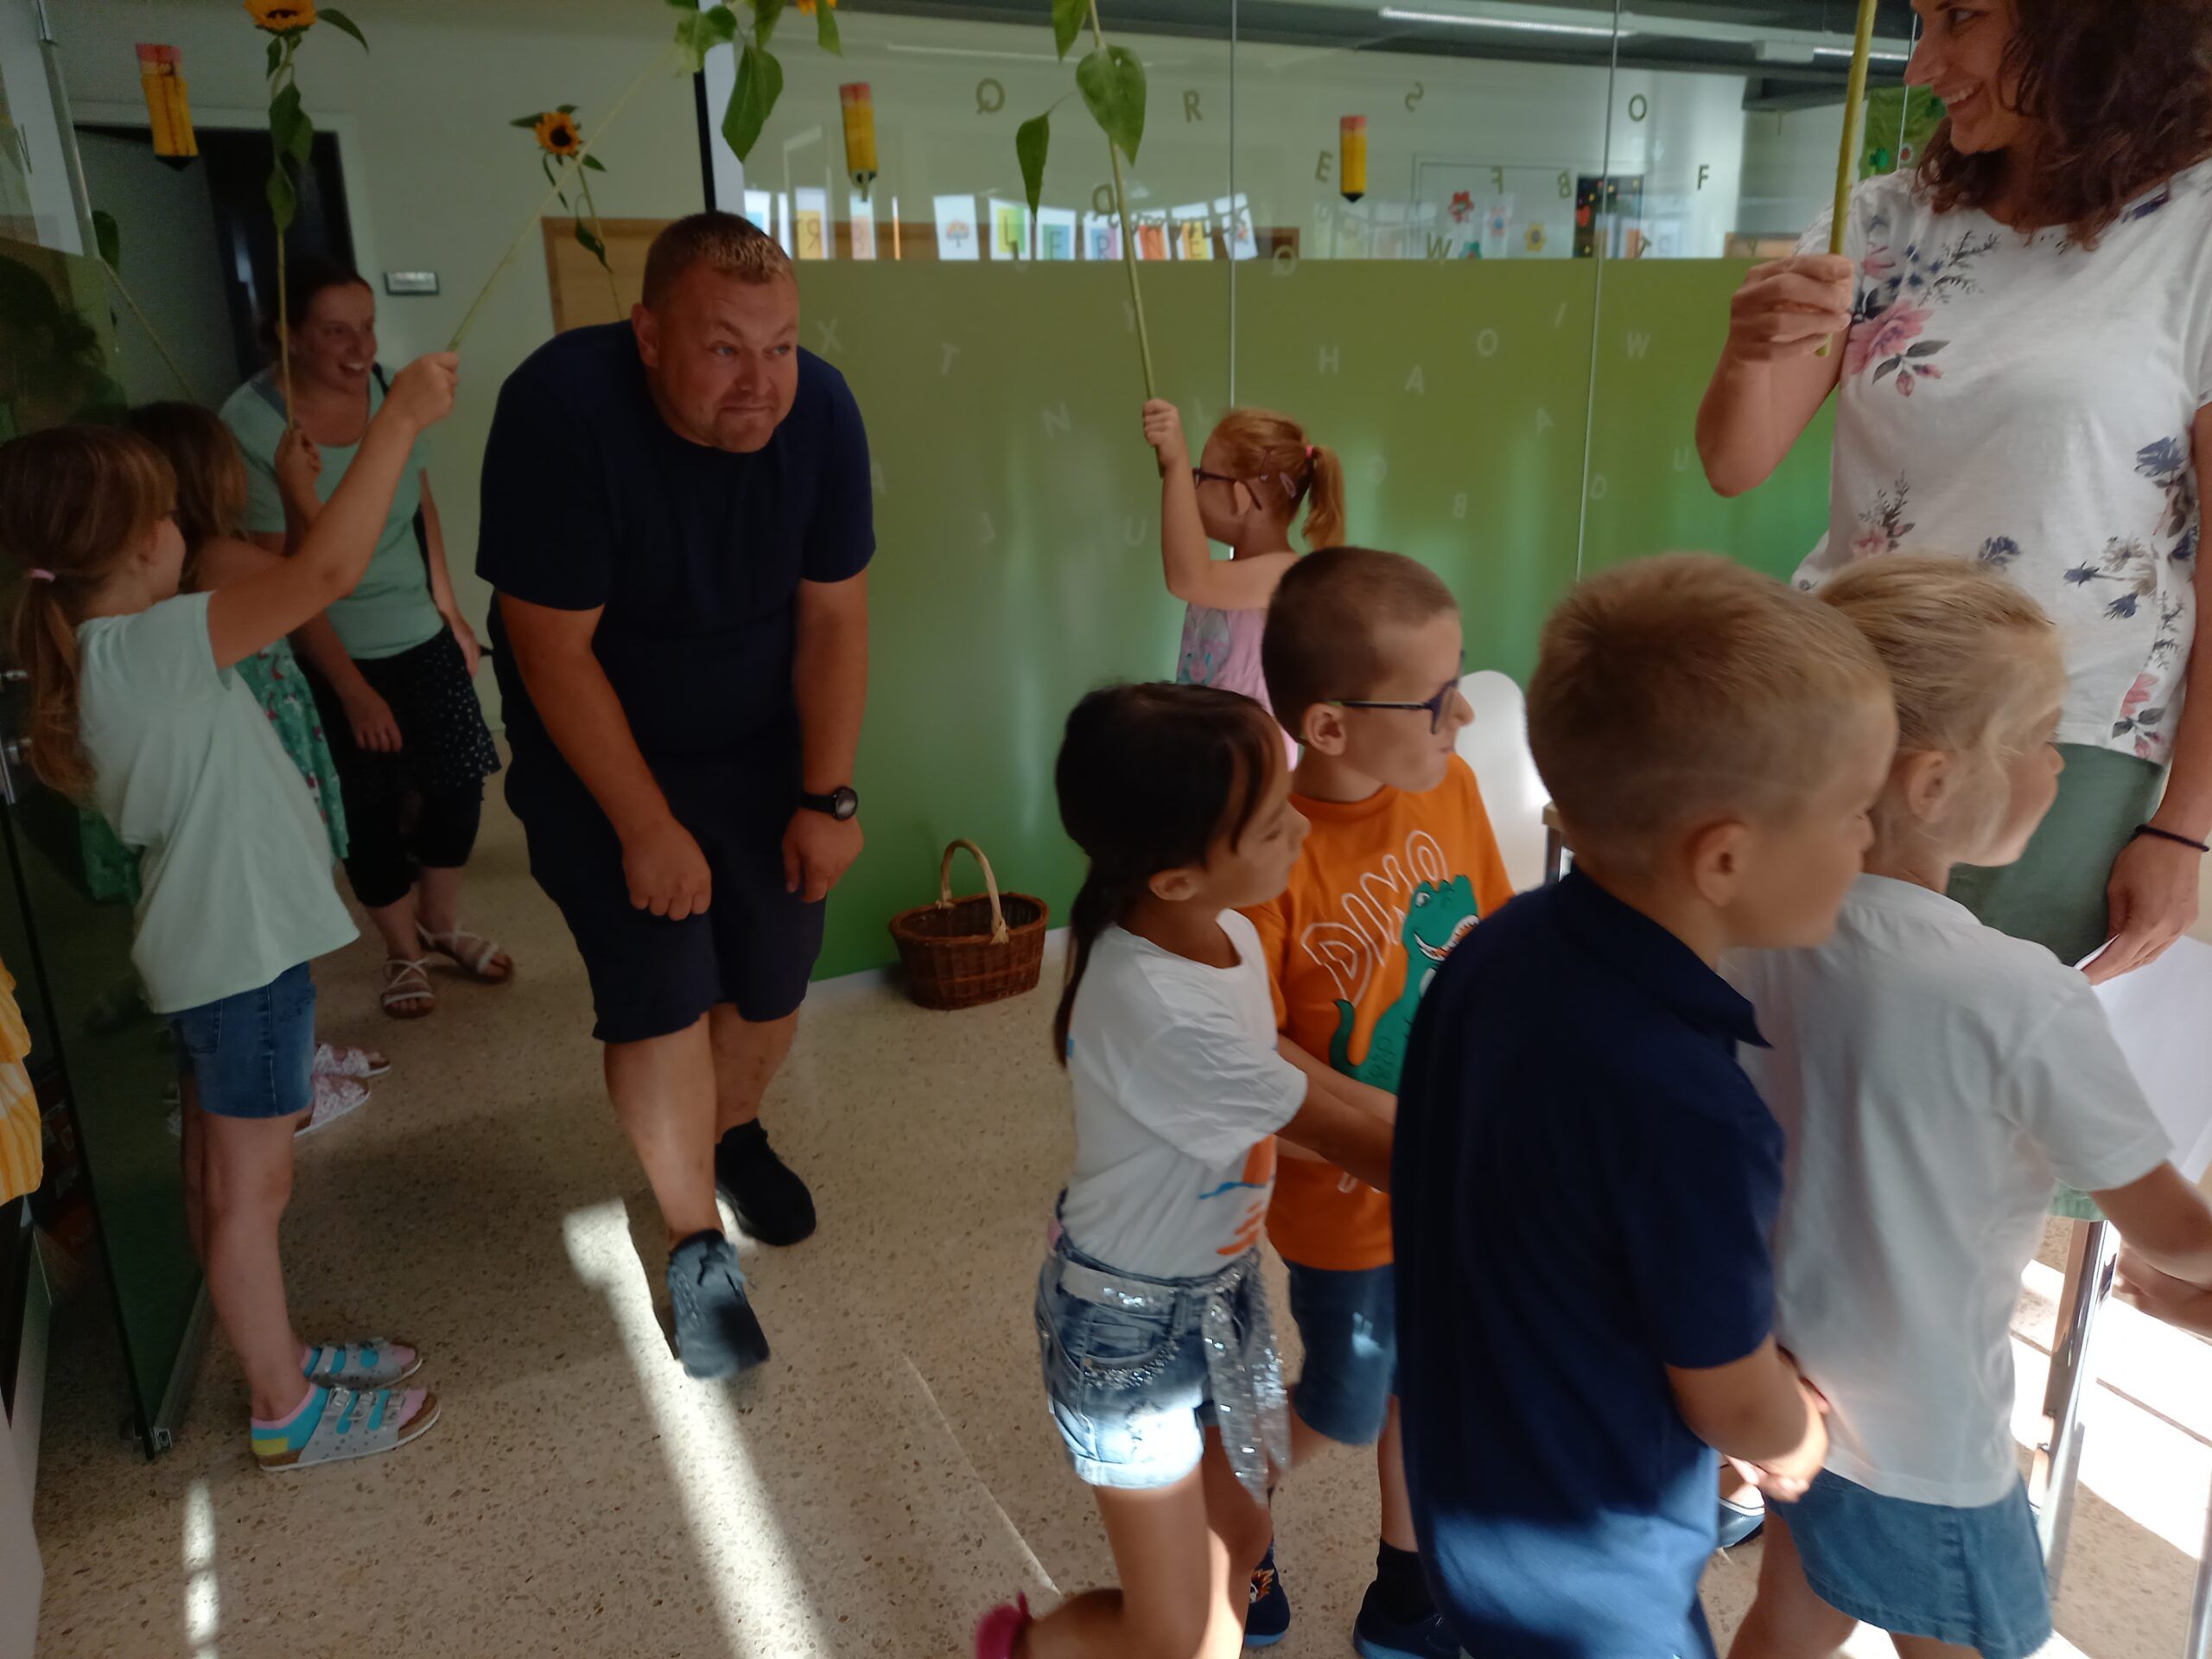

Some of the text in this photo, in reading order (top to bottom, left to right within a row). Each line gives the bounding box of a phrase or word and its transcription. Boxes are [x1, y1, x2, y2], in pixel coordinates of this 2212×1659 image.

[1182, 89, 1203, 123] R
[1629, 92, 1647, 122] O
[1314, 149, 1334, 183] E
[1697, 163, 1710, 191] F
[816, 318, 842, 356] X
[1476, 327, 1499, 358] O
[1626, 330, 1651, 360] W
[941, 341, 962, 378] T
[1319, 345, 1340, 375] H
[1404, 364, 1425, 396] A
[1040, 401, 1072, 439] N
[1536, 406, 1554, 436] A
[1123, 515, 1148, 548] U
[1300, 830, 1449, 1008] DINO
